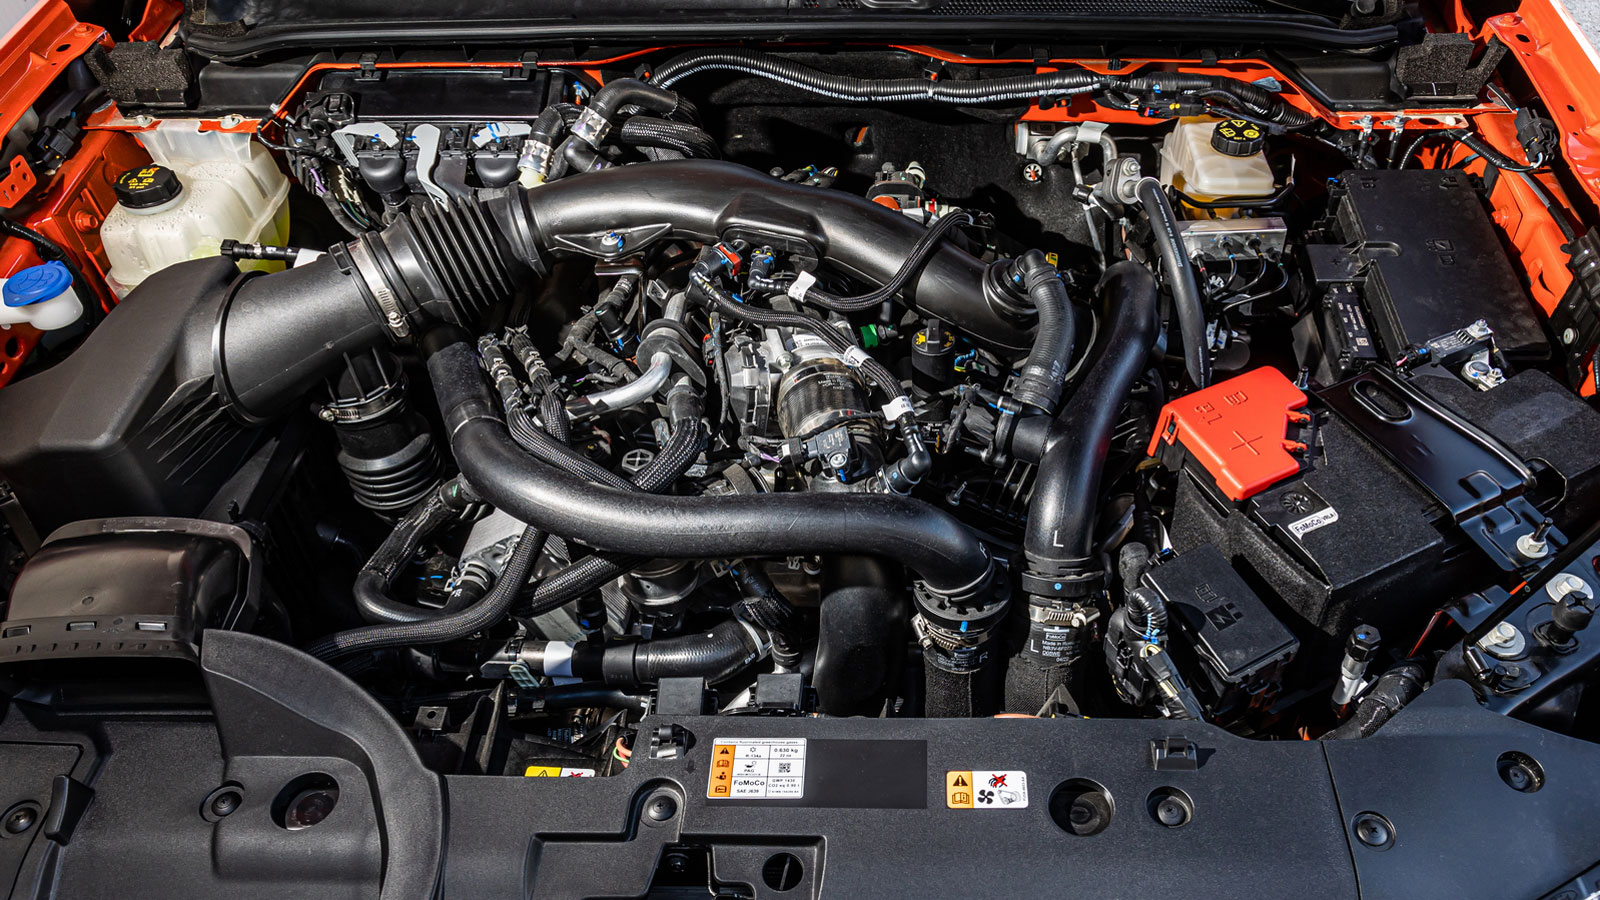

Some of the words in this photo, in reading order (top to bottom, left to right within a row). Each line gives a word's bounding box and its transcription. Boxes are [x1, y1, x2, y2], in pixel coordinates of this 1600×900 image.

[1295, 519, 1321, 532] FoMoCo
[1053, 530, 1065, 548] L
[1030, 639, 1039, 654] L
